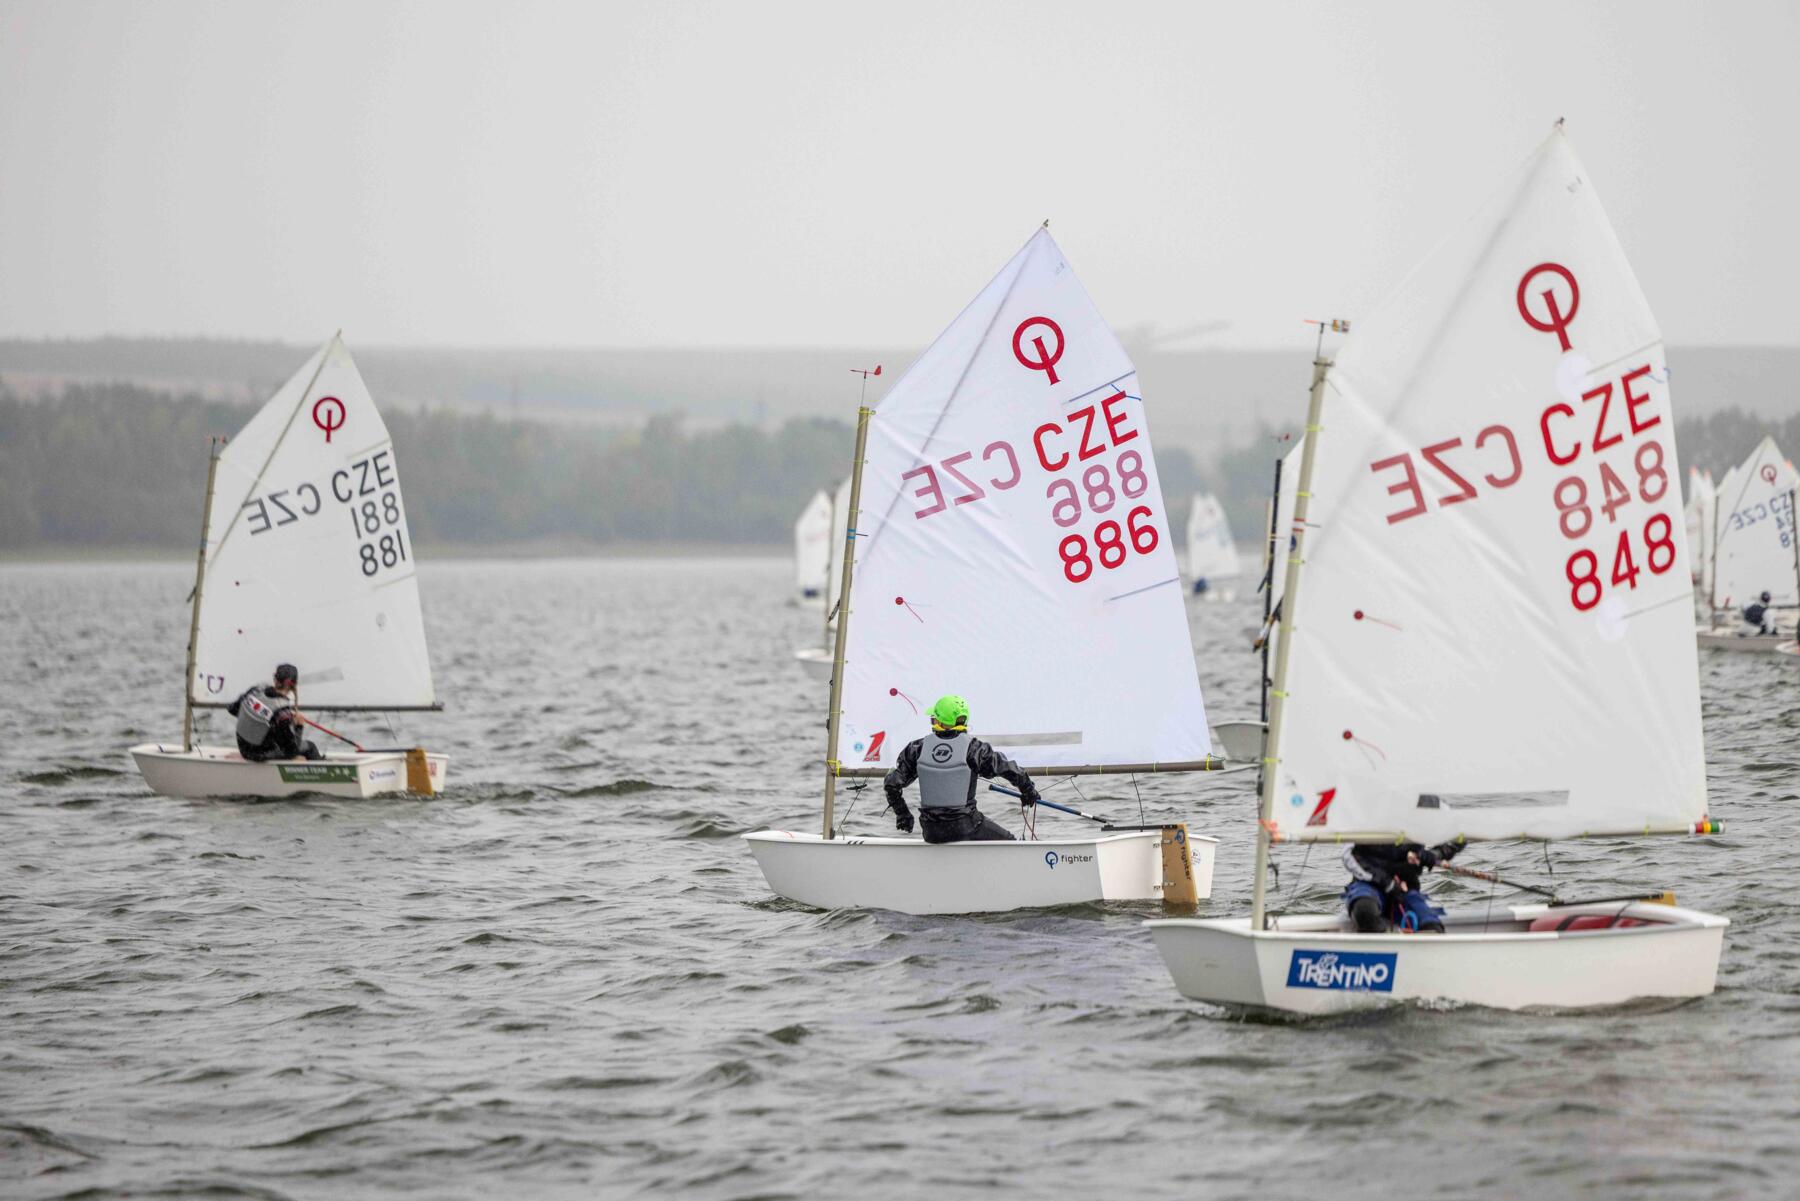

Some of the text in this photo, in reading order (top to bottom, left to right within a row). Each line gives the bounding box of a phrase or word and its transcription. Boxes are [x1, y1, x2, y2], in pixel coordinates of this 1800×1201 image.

[1033, 390, 1138, 472] CZE
[1540, 363, 1661, 466] CZE
[331, 450, 394, 503] CZE
[1769, 492, 1790, 514] CZ
[359, 529, 405, 576] 881
[1058, 505, 1159, 584] 886
[1565, 512, 1676, 612] 848
[1061, 854, 1093, 864] fighter
